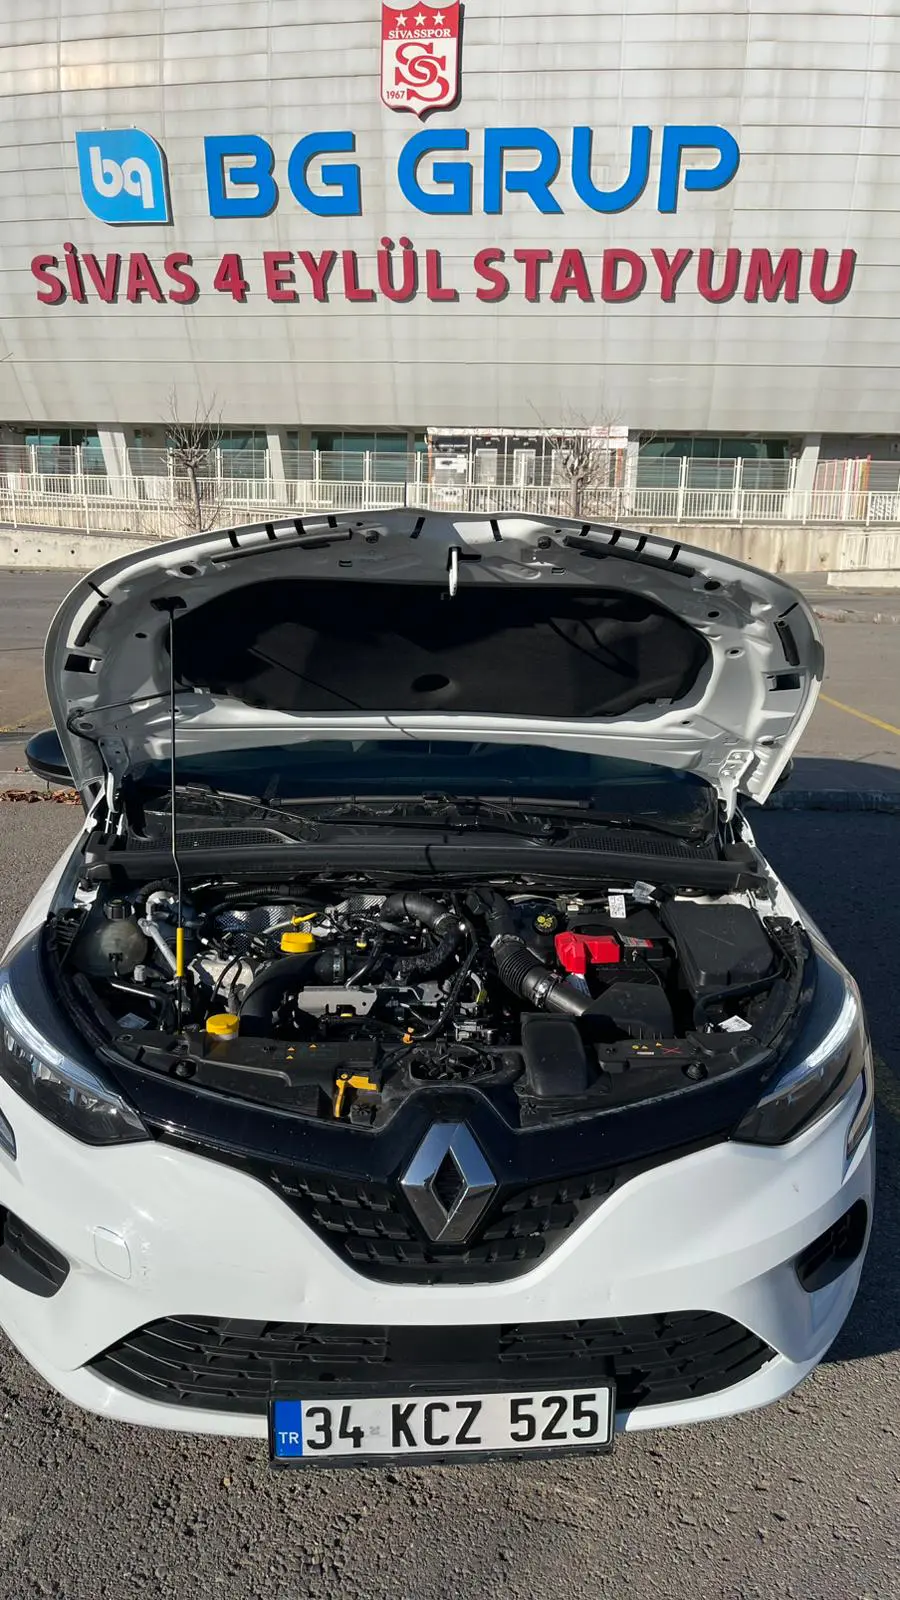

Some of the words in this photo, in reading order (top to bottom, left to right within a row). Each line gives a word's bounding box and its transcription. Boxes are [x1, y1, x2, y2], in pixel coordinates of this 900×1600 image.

[388, 28, 451, 39] SİVASSPOR
[386, 90, 405, 100] 1967
[204, 131, 363, 218] BG
[398, 126, 740, 215] GRUP
[31, 242, 200, 305] SİVAS
[213, 253, 250, 303] 4
[263, 236, 460, 304] EYLÜL
[474, 247, 857, 304] STADYUMU
[278, 1432, 300, 1445] TR
[306, 1406, 364, 1450] 34
[392, 1400, 482, 1448] KCZ
[510, 1393, 598, 1442] 525
